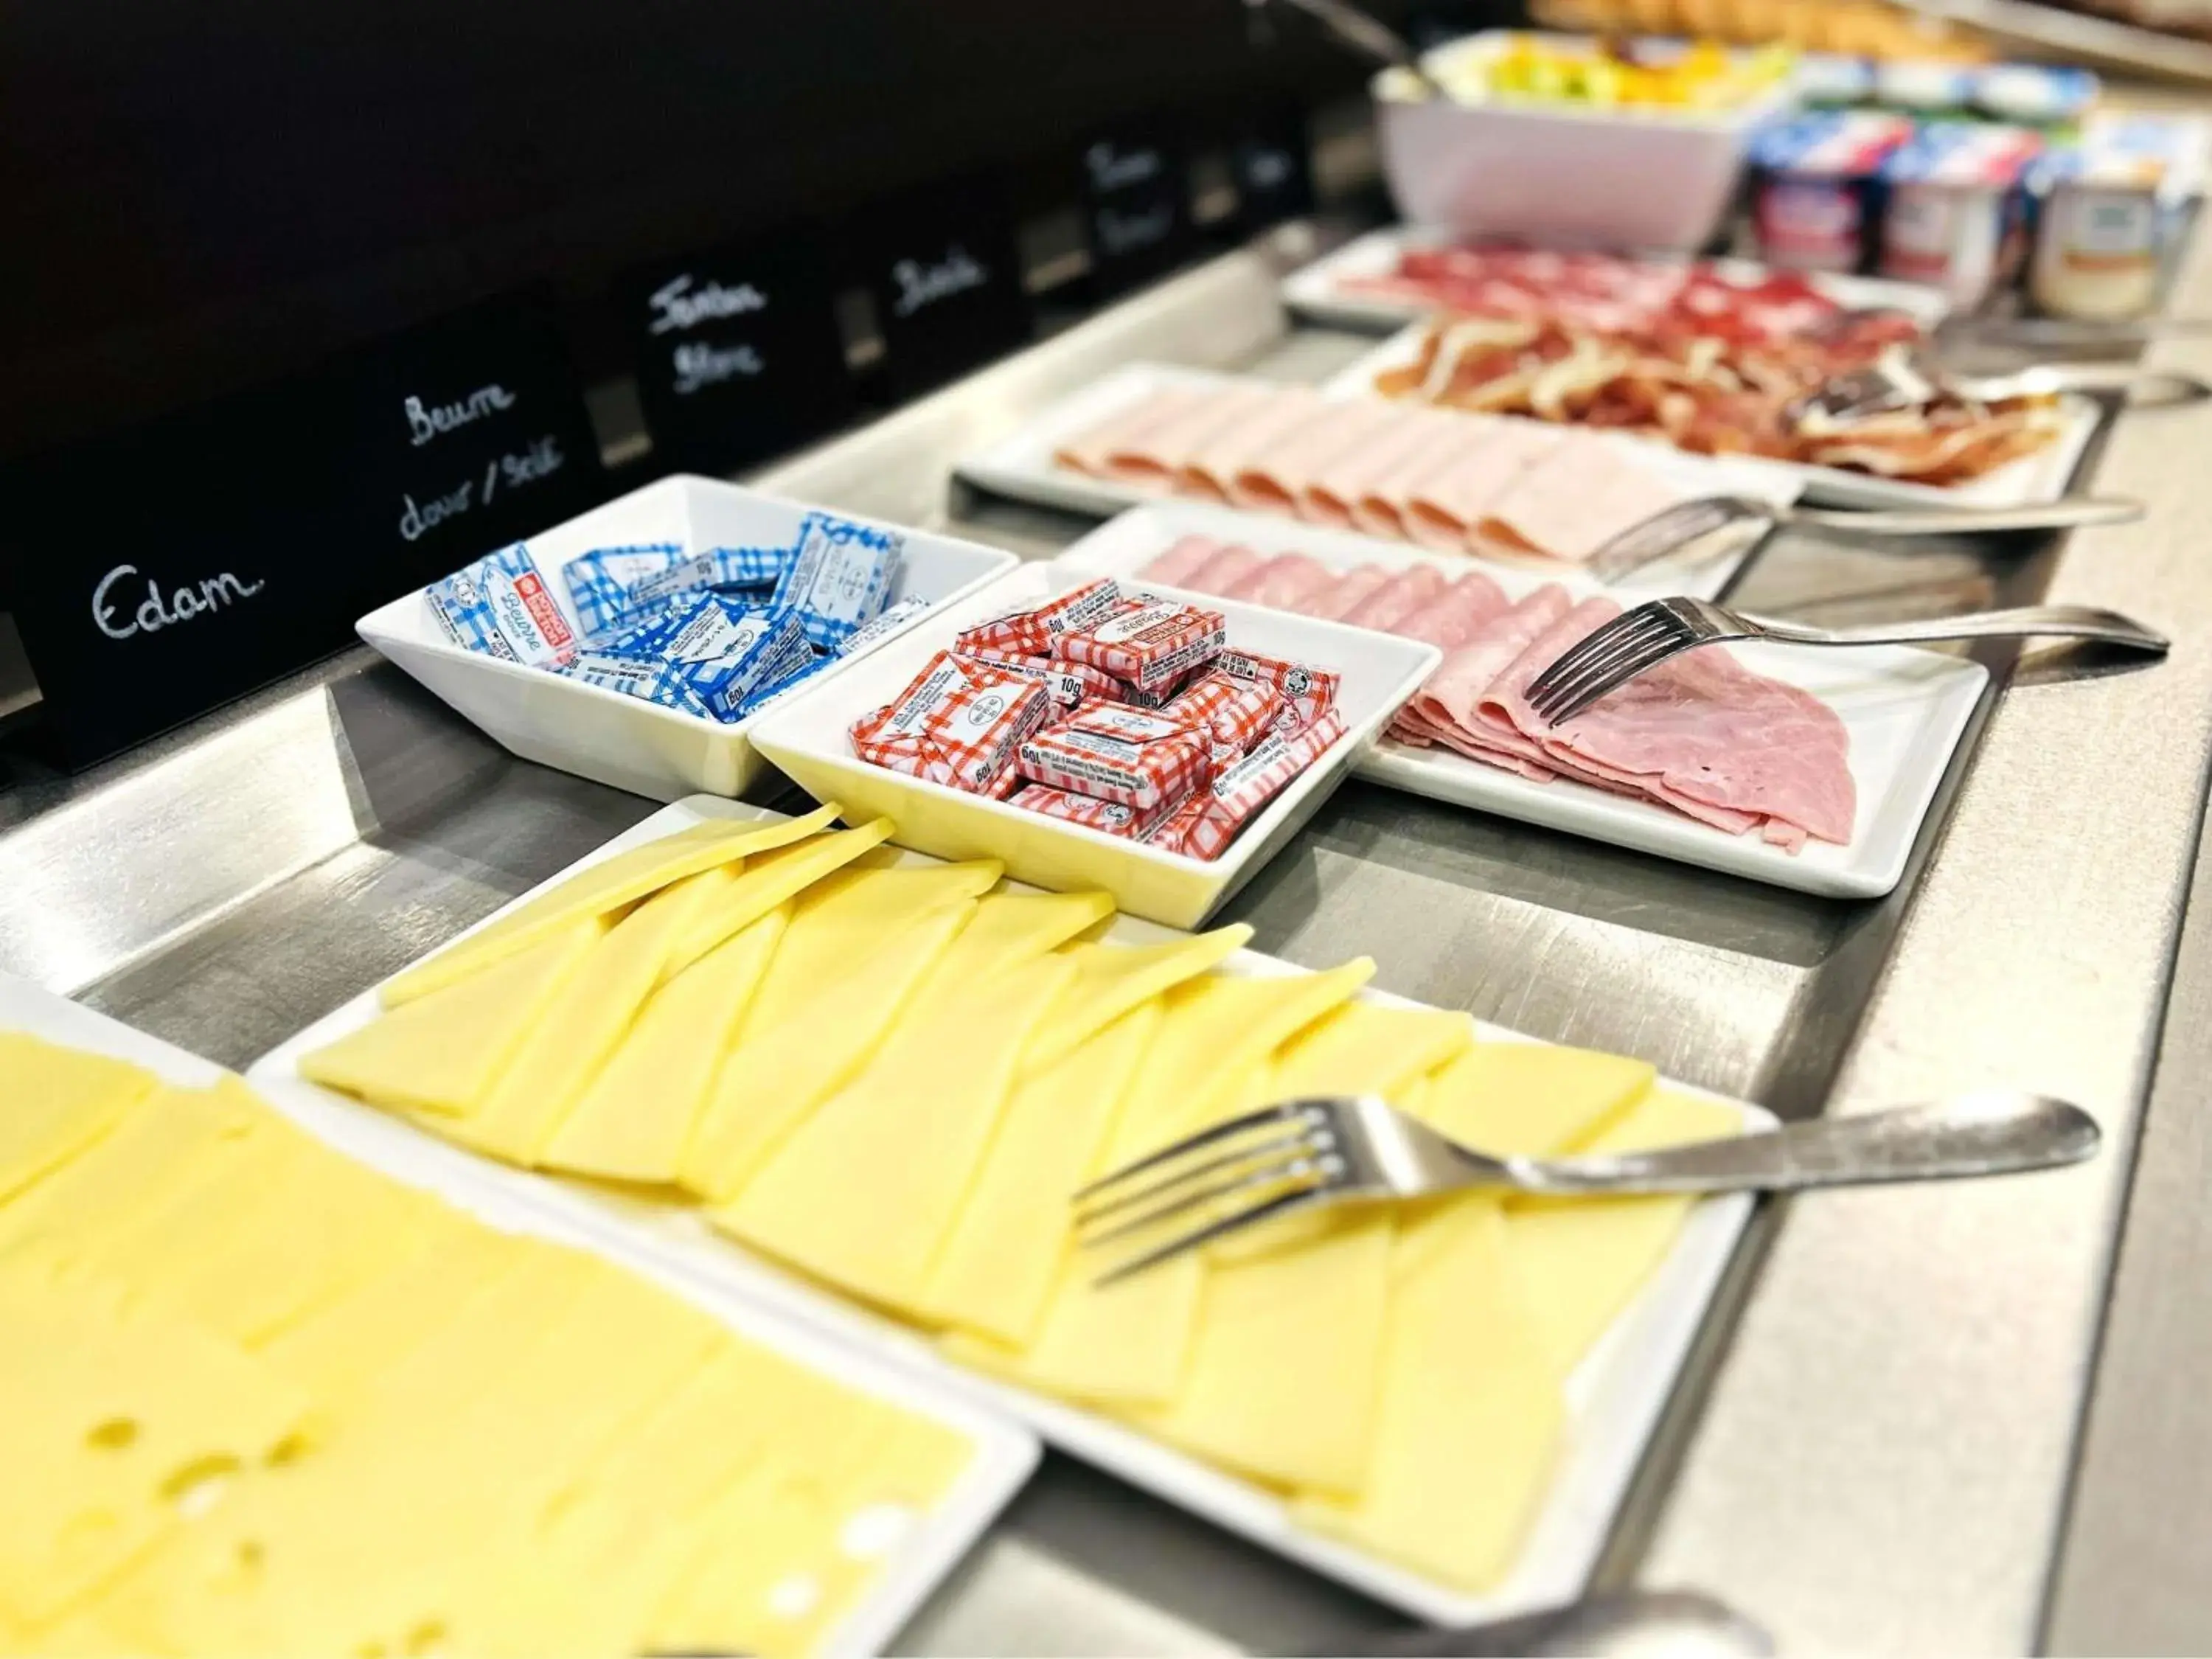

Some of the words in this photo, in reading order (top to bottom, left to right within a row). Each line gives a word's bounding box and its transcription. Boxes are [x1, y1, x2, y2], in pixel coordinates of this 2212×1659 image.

[405, 383, 517, 447] Beurre
[92, 565, 265, 639] Edam
[501, 591, 541, 652] Beurre
[1060, 677, 1082, 697] 10g
[974, 762, 991, 784] 10g
